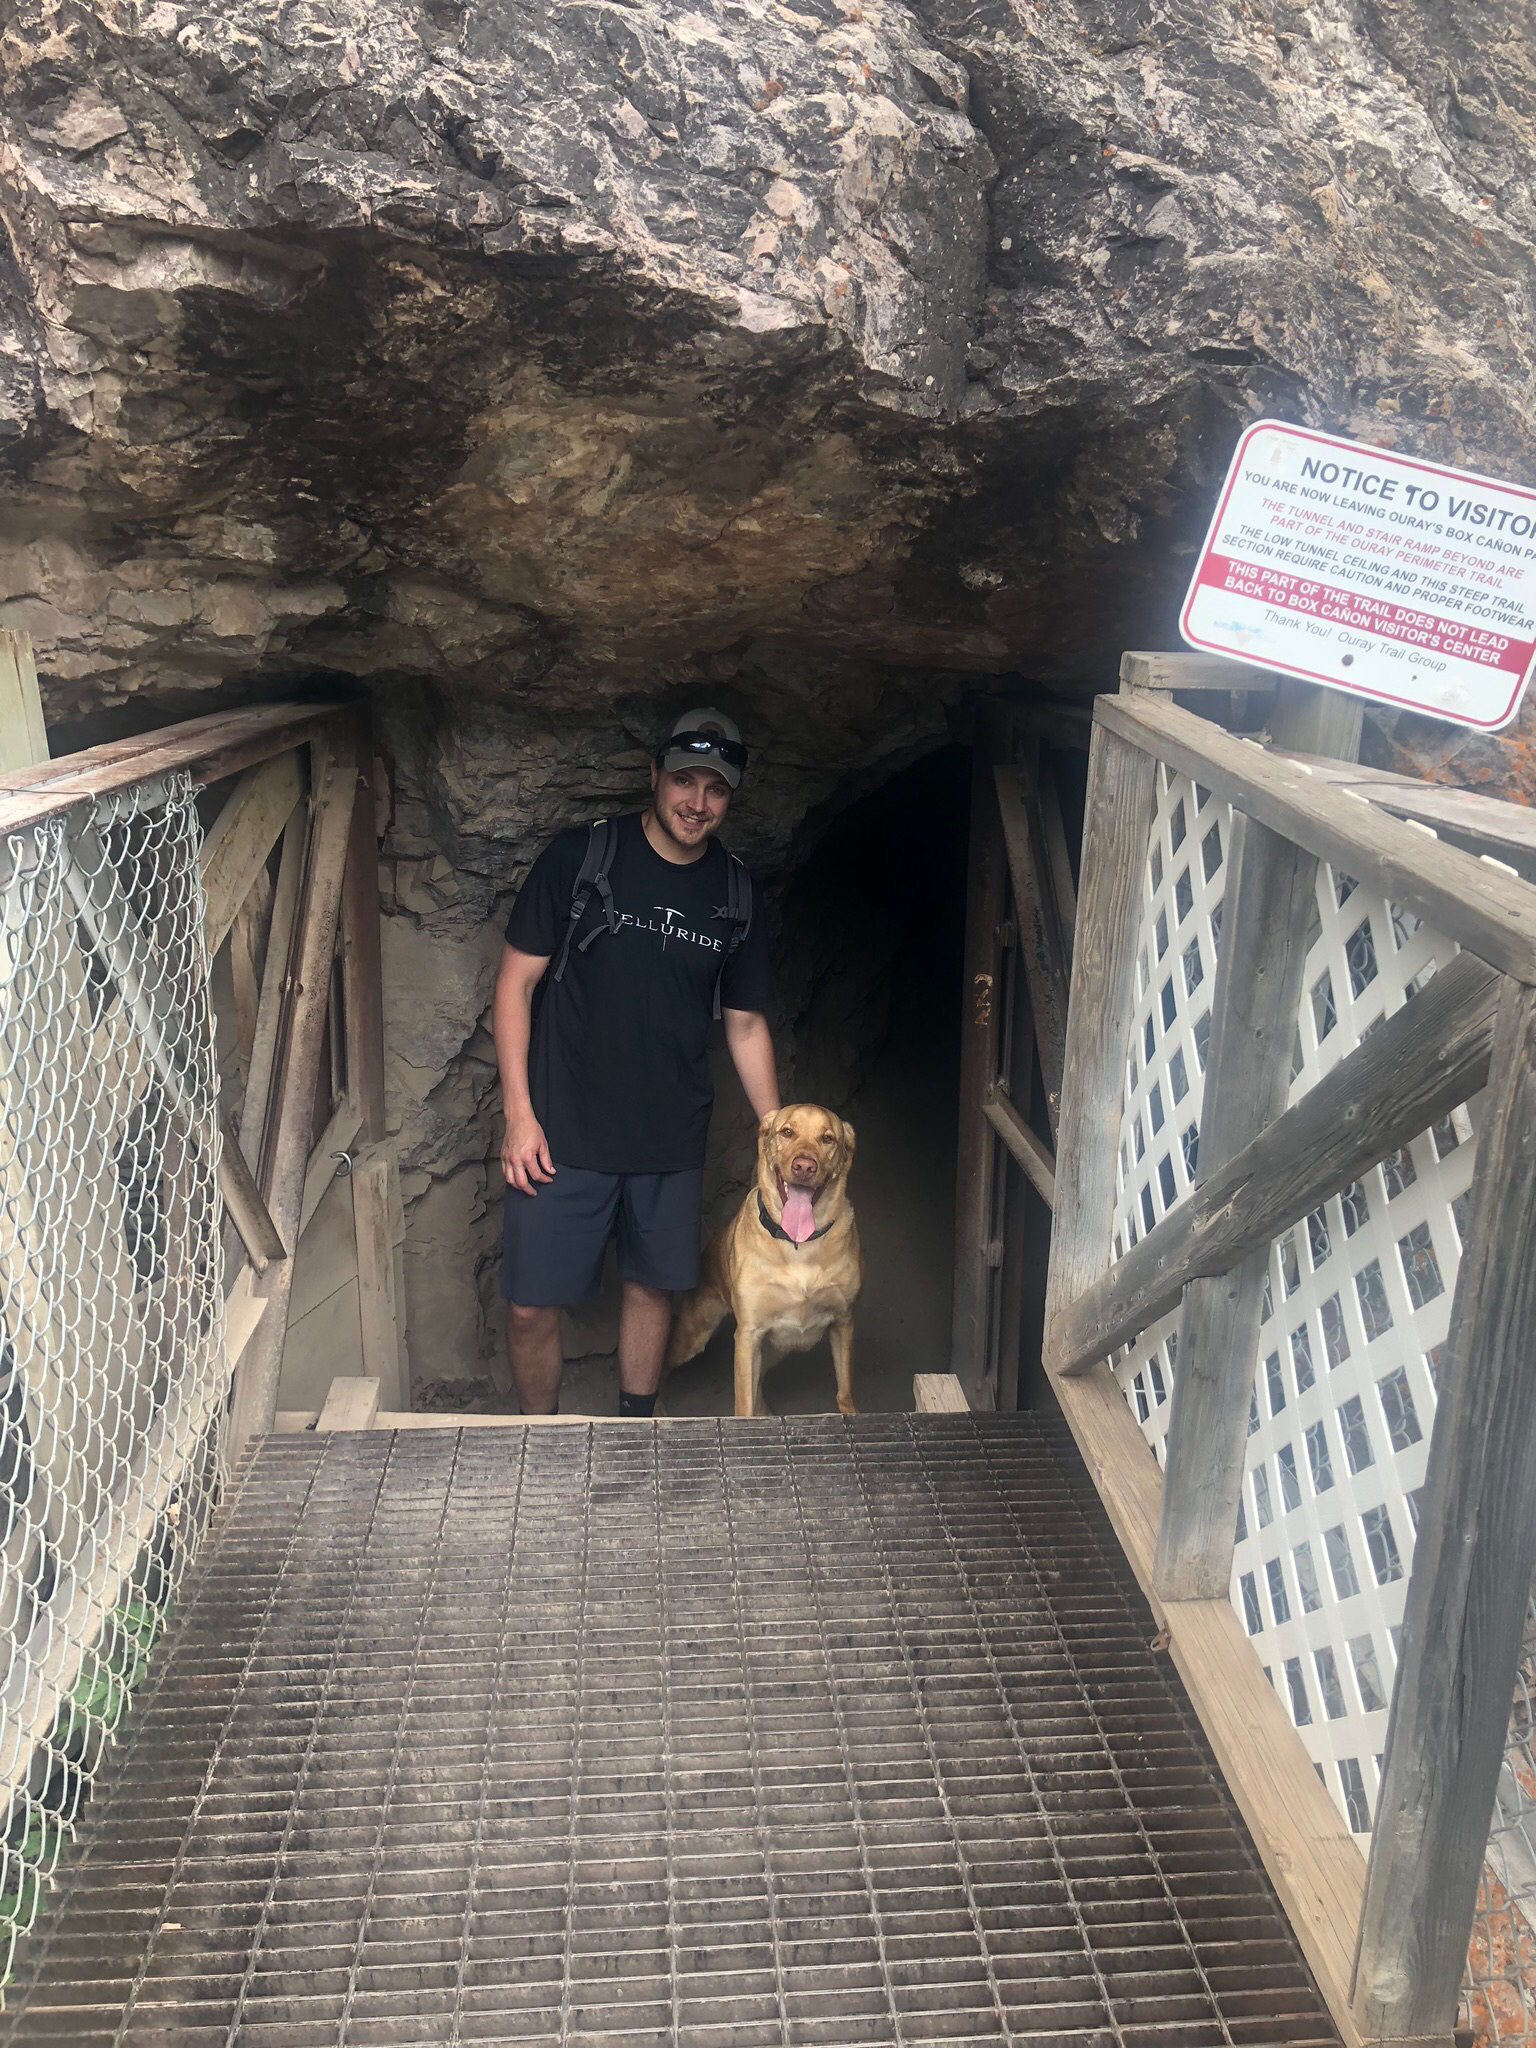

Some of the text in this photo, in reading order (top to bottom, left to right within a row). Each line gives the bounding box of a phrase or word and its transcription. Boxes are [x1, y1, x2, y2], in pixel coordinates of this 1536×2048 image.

[1244, 470, 1271, 486] YOU
[1271, 479, 1298, 494] ARE
[1300, 487, 1332, 503] NOW
[1332, 495, 1386, 519] LEAVING
[1389, 511, 1443, 535] OURAY'S
[1445, 527, 1474, 543] BOX
[1476, 535, 1522, 556] CAÑON
[1300, 457, 1399, 501] NOTICE
[1405, 484, 1440, 511] TO
[1221, 534, 1535, 630] SECTION REQUIRE CAUTION AND PROPER FOOTWEAR
[1239, 524, 1525, 614] THE LOW TUNNEL CEILING AND THIS STEEP TRAIL
[1261, 498, 1525, 580] THE TUNNEL AND STAIR RAMP BEYOND ARE
[1270, 515, 1504, 589] PART OF THE OURAY PERIMETER TRAIL
[1224, 575, 1501, 665] BACK TO BOX CAÑON VISITOR'S CENTER
[1228, 560, 1509, 651] THIS PART OF THE TRAIL DOES NOT LEAD
[1264, 609, 1447, 672] Thank You! Ouray Trail Group
